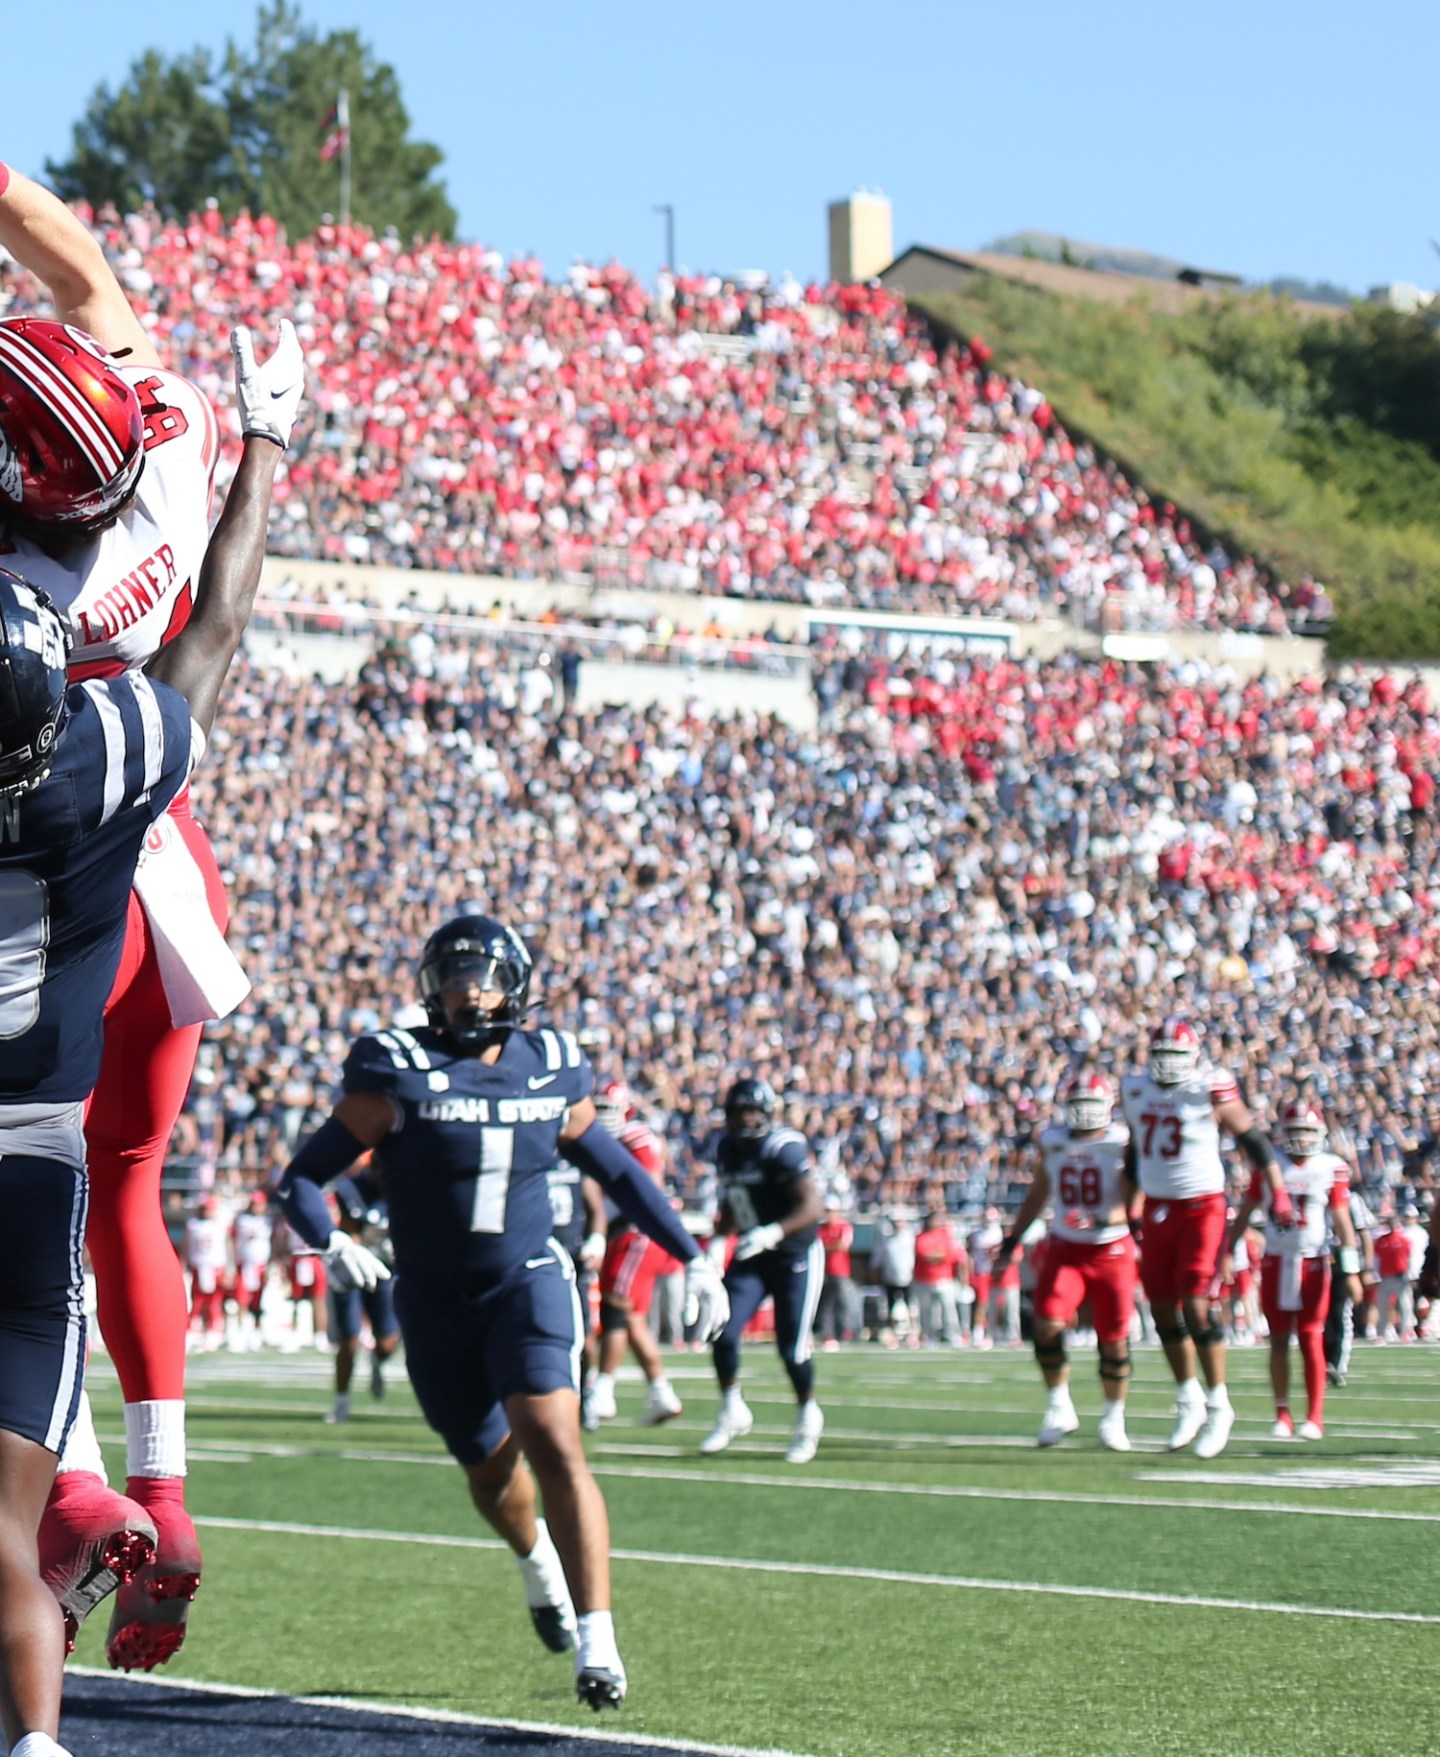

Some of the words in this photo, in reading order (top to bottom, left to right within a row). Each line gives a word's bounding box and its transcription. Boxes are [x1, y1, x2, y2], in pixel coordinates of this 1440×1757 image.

[77, 543, 177, 646] LOHNER
[418, 1098, 490, 1122] UTAH
[497, 1096, 567, 1123] STATE
[1140, 1113, 1182, 1159] 73
[470, 1126, 514, 1234] 1
[1060, 1166, 1101, 1206] 68
